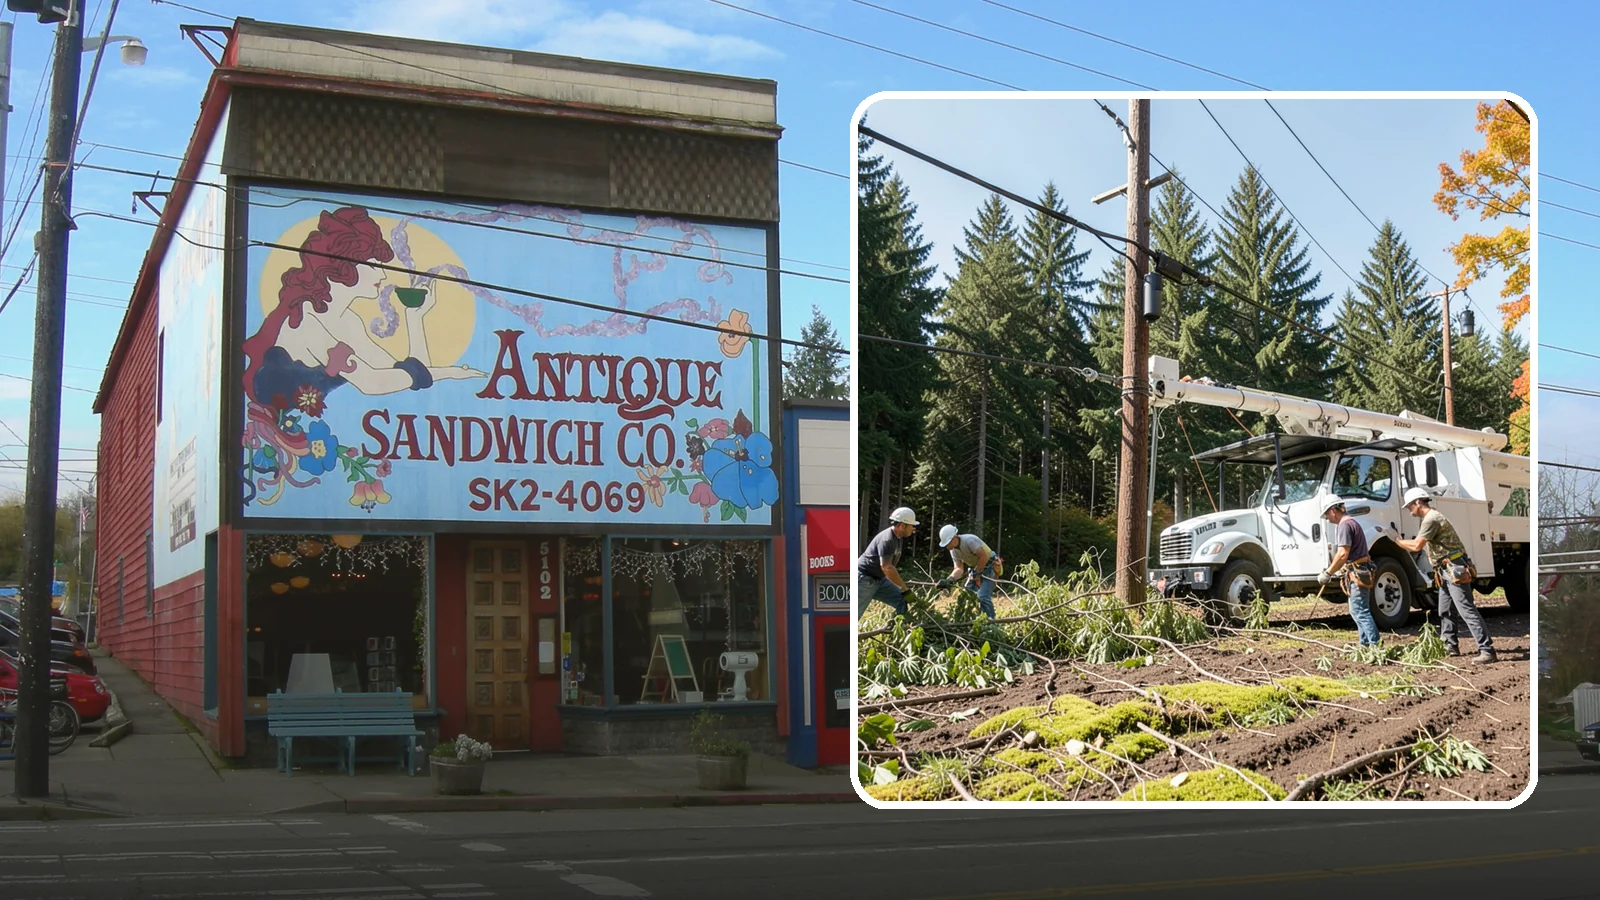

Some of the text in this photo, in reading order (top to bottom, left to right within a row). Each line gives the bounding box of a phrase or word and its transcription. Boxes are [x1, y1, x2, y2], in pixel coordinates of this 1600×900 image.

[476, 329, 724, 420] ANTIQUE
[361, 409, 684, 469] SANDWICH CO.
[469, 478, 645, 513] SK2-4069
[539, 541, 552, 600] 5102
[809, 555, 835, 569] BOOKS
